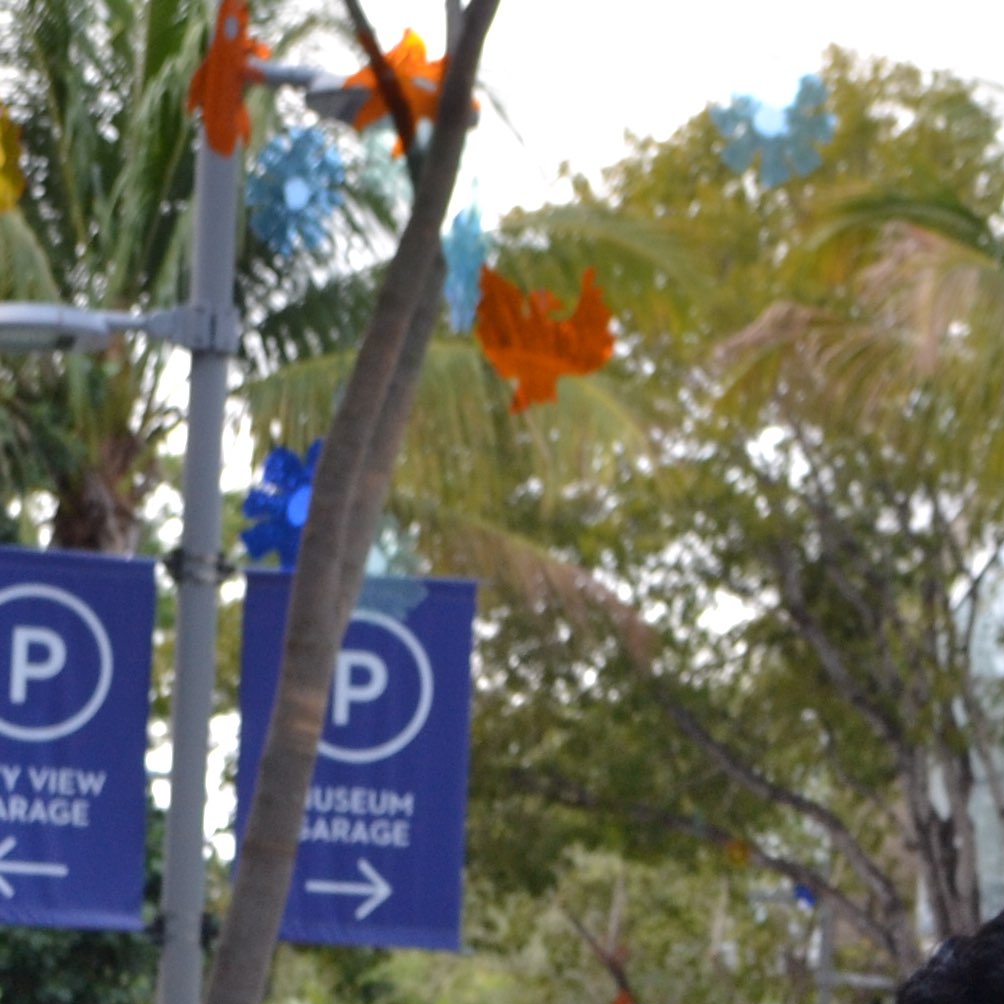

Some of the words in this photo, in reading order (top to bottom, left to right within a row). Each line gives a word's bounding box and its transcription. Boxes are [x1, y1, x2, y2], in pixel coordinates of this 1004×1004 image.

[10, 625, 67, 704] P
[332, 649, 388, 726] P
[28, 766, 107, 796] VIEW
